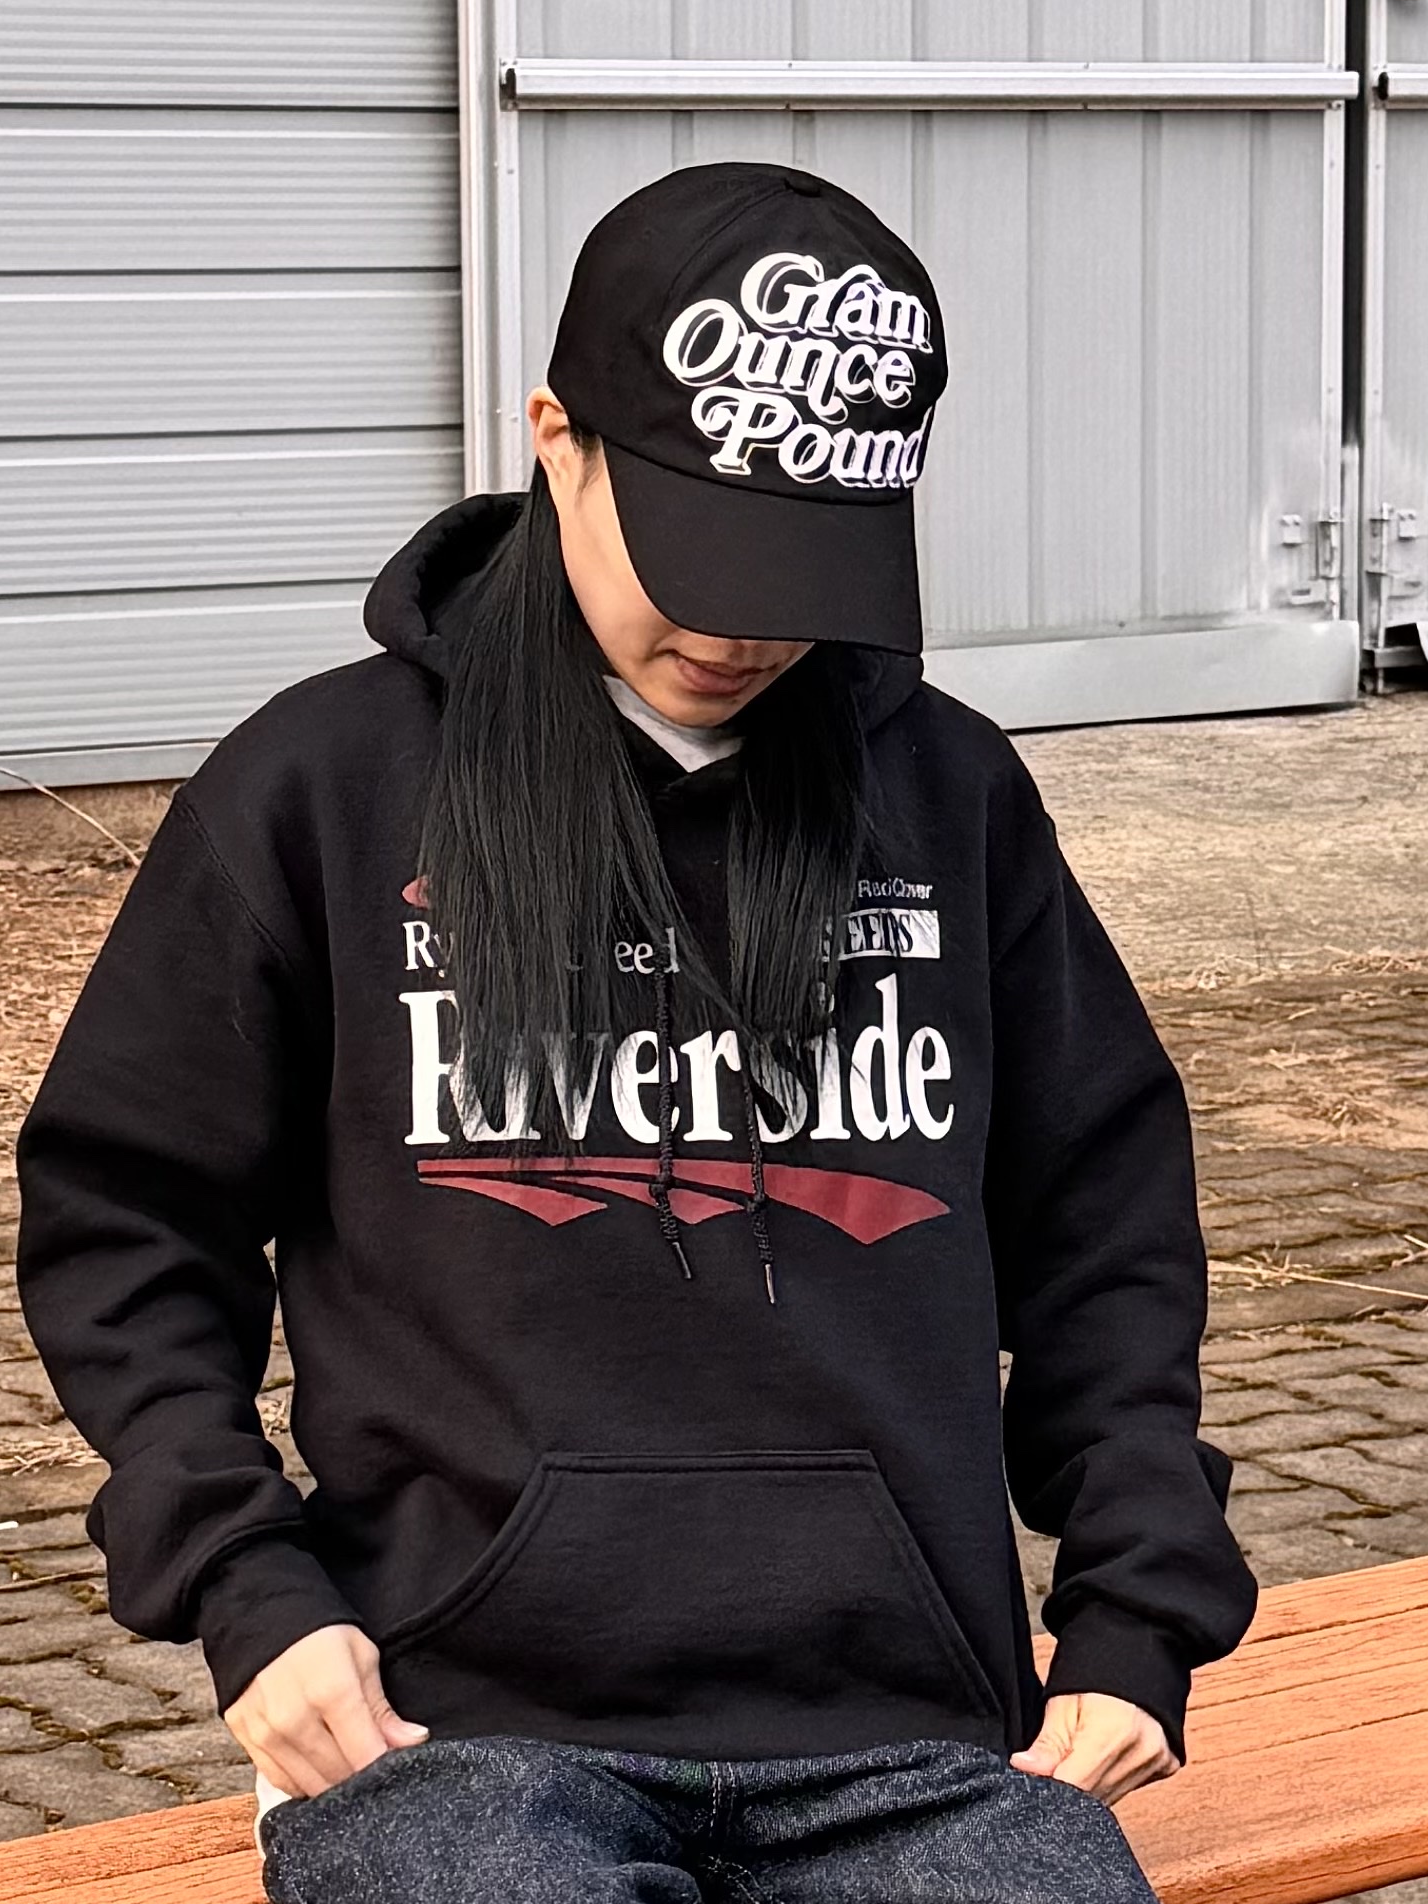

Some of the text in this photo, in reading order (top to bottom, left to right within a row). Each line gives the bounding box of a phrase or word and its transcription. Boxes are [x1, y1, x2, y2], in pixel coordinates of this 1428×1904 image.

[740, 252, 933, 354] Gram
[662, 298, 916, 425] Ounce
[691, 386, 933, 489] Pound
